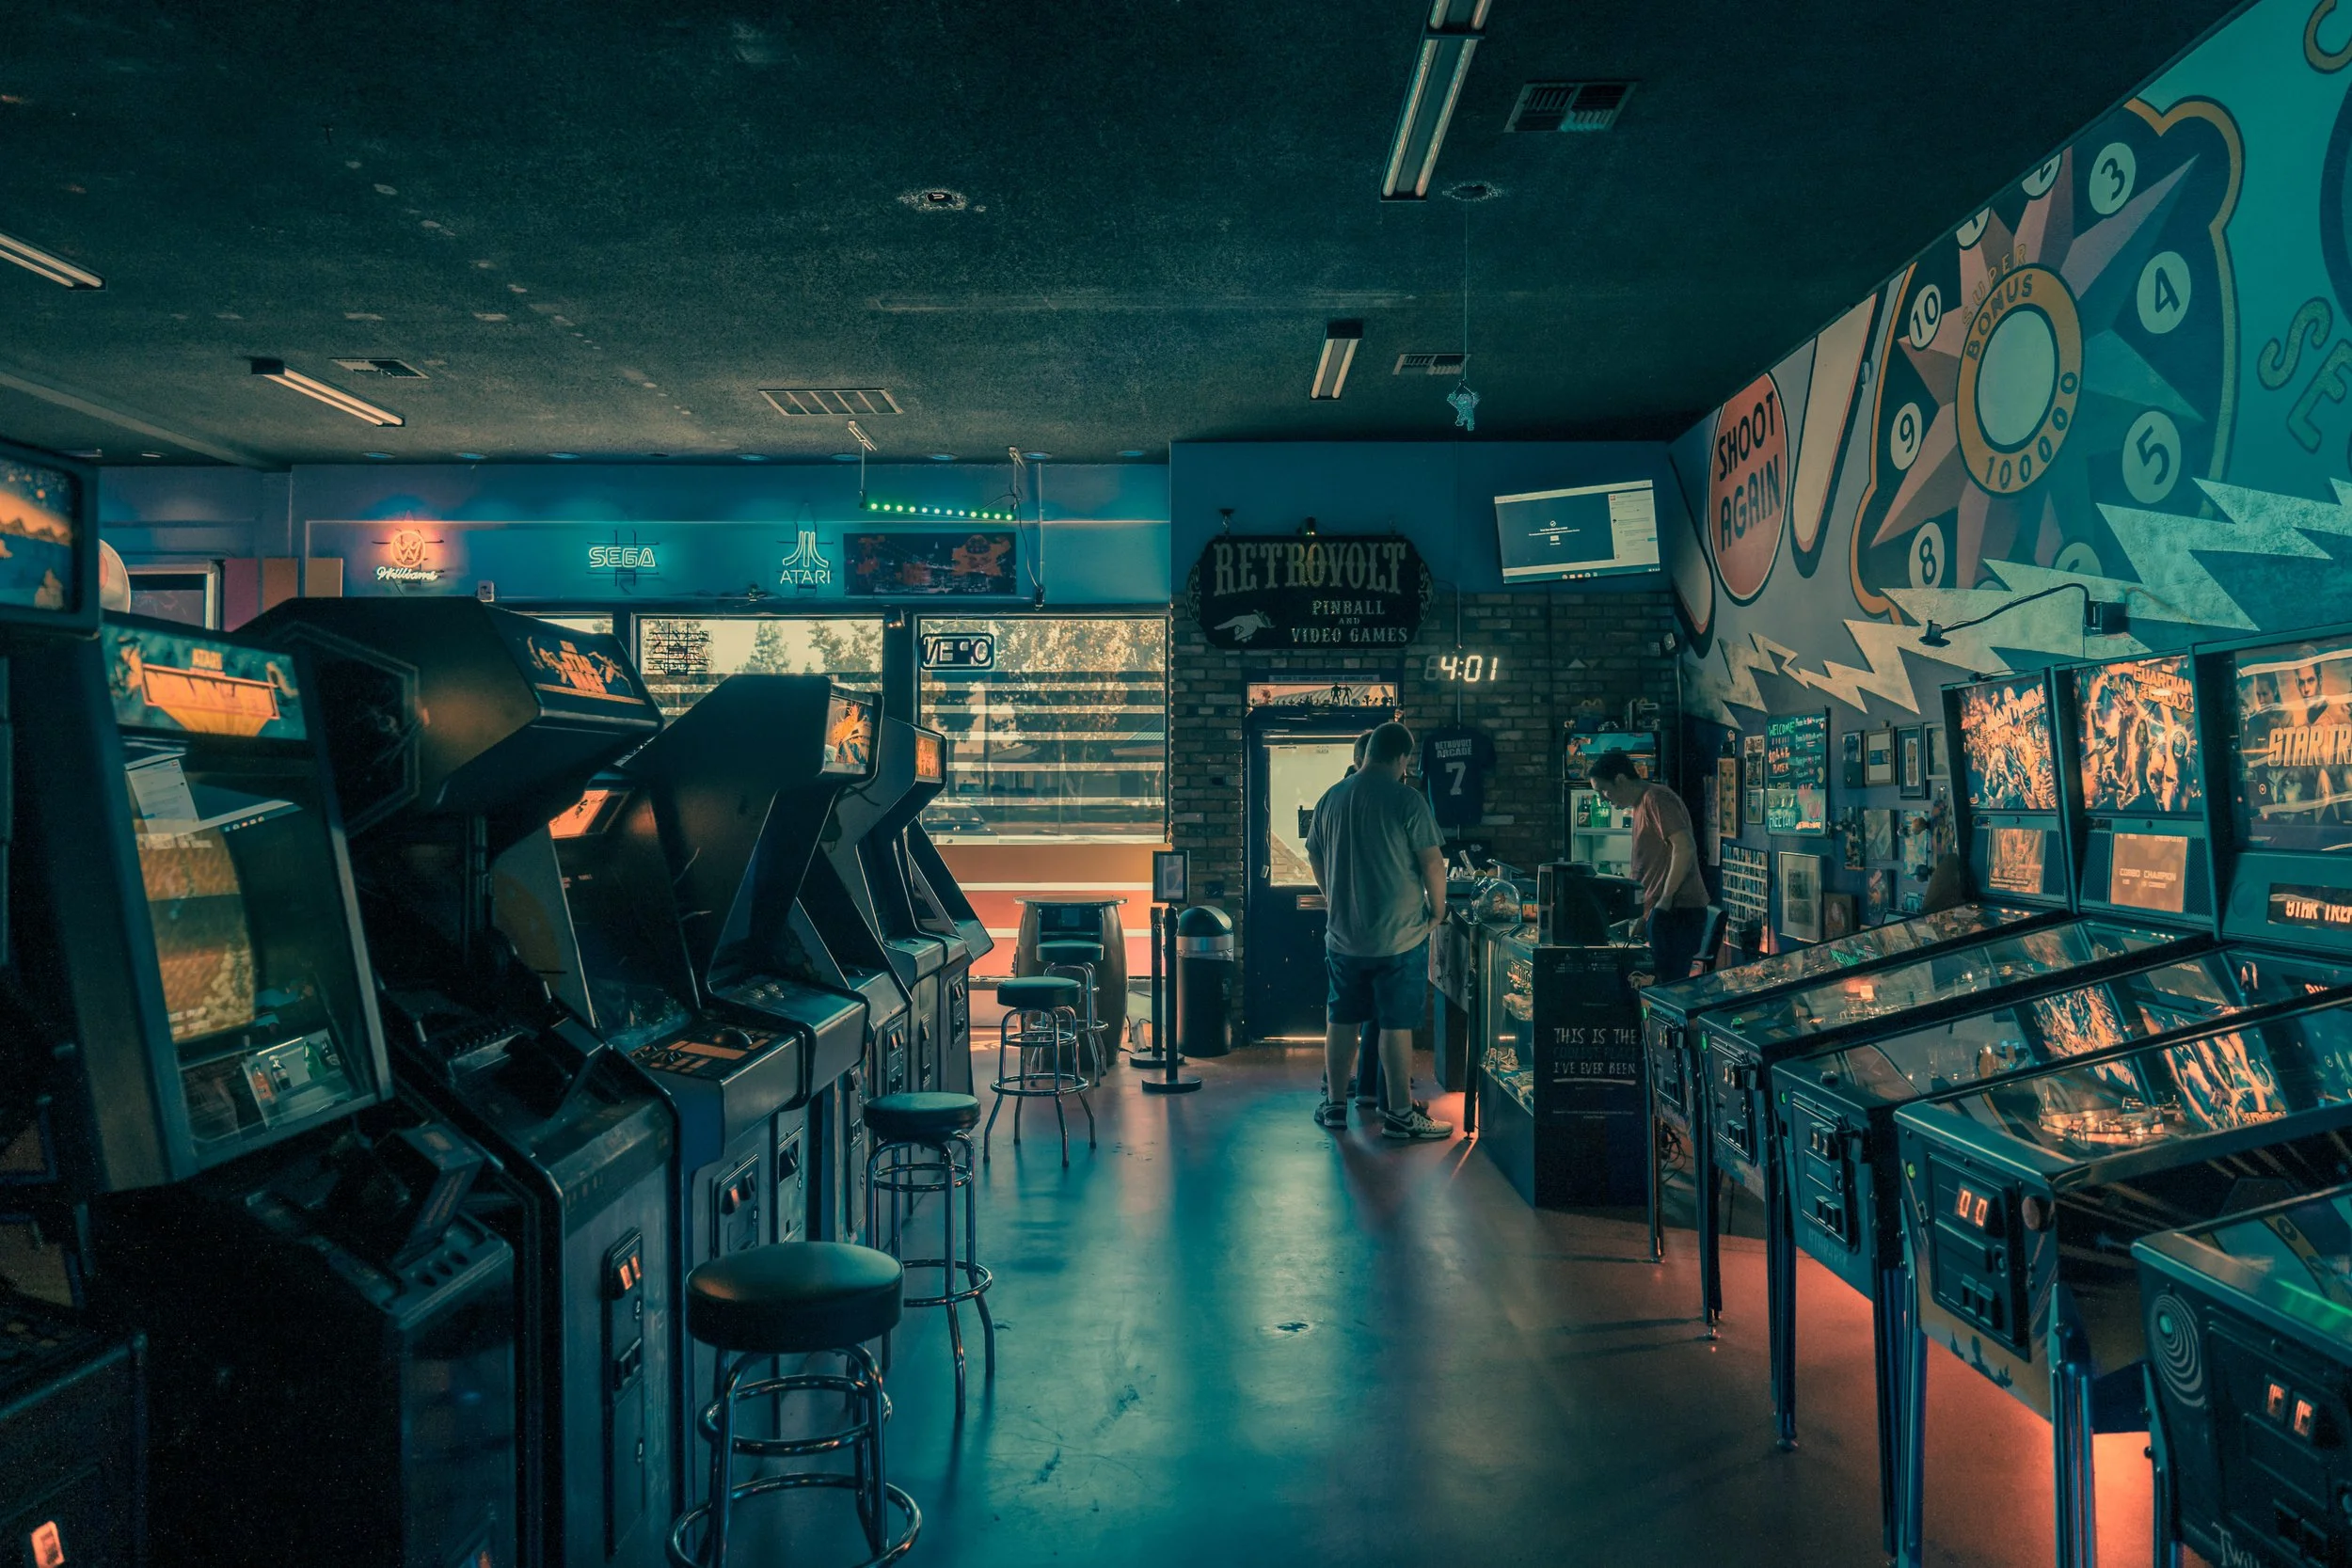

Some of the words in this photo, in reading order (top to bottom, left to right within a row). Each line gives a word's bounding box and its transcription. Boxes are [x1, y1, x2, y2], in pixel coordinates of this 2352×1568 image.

[2101, 158, 2125, 202] 3
[1962, 244, 2027, 329] SUPER
[2154, 267, 2180, 313] 4
[1913, 291, 1939, 341] 10
[1965, 274, 2033, 361] BONUS
[1718, 390, 1775, 482] SHOOT
[1899, 412, 1915, 453] 9
[2137, 425, 2169, 485] 5
[1720, 453, 1781, 552] AGAIN
[376, 566, 437, 581] Williams
[589, 546, 656, 567] SEGA
[1214, 542, 1407, 597] RETROVOLT
[1919, 536, 1937, 585] 8
[780, 569, 831, 584] ATARI
[1311, 600, 1386, 615] PINBALL
[1339, 617, 1360, 626] AND
[1291, 627, 1342, 642] VIDEO
[1350, 626, 1407, 642] GAMES
[1440, 655, 1498, 682] 4:01
[1435, 738, 1471, 751] RETROVOLT
[1437, 747, 1472, 758] ARCADE
[2267, 725, 2324, 767] STAR
[2327, 723, 2352, 765] TR
[1445, 761, 1467, 796] 7
[1553, 1027, 1585, 1044] THIS
[1592, 1028, 1606, 1044] IS
[1613, 1028, 1637, 1044] THE
[1552, 1061, 1576, 1074] I'VE
[1581, 1062, 1603, 1074] EVER
[1609, 1062, 1636, 1075] BEEN
